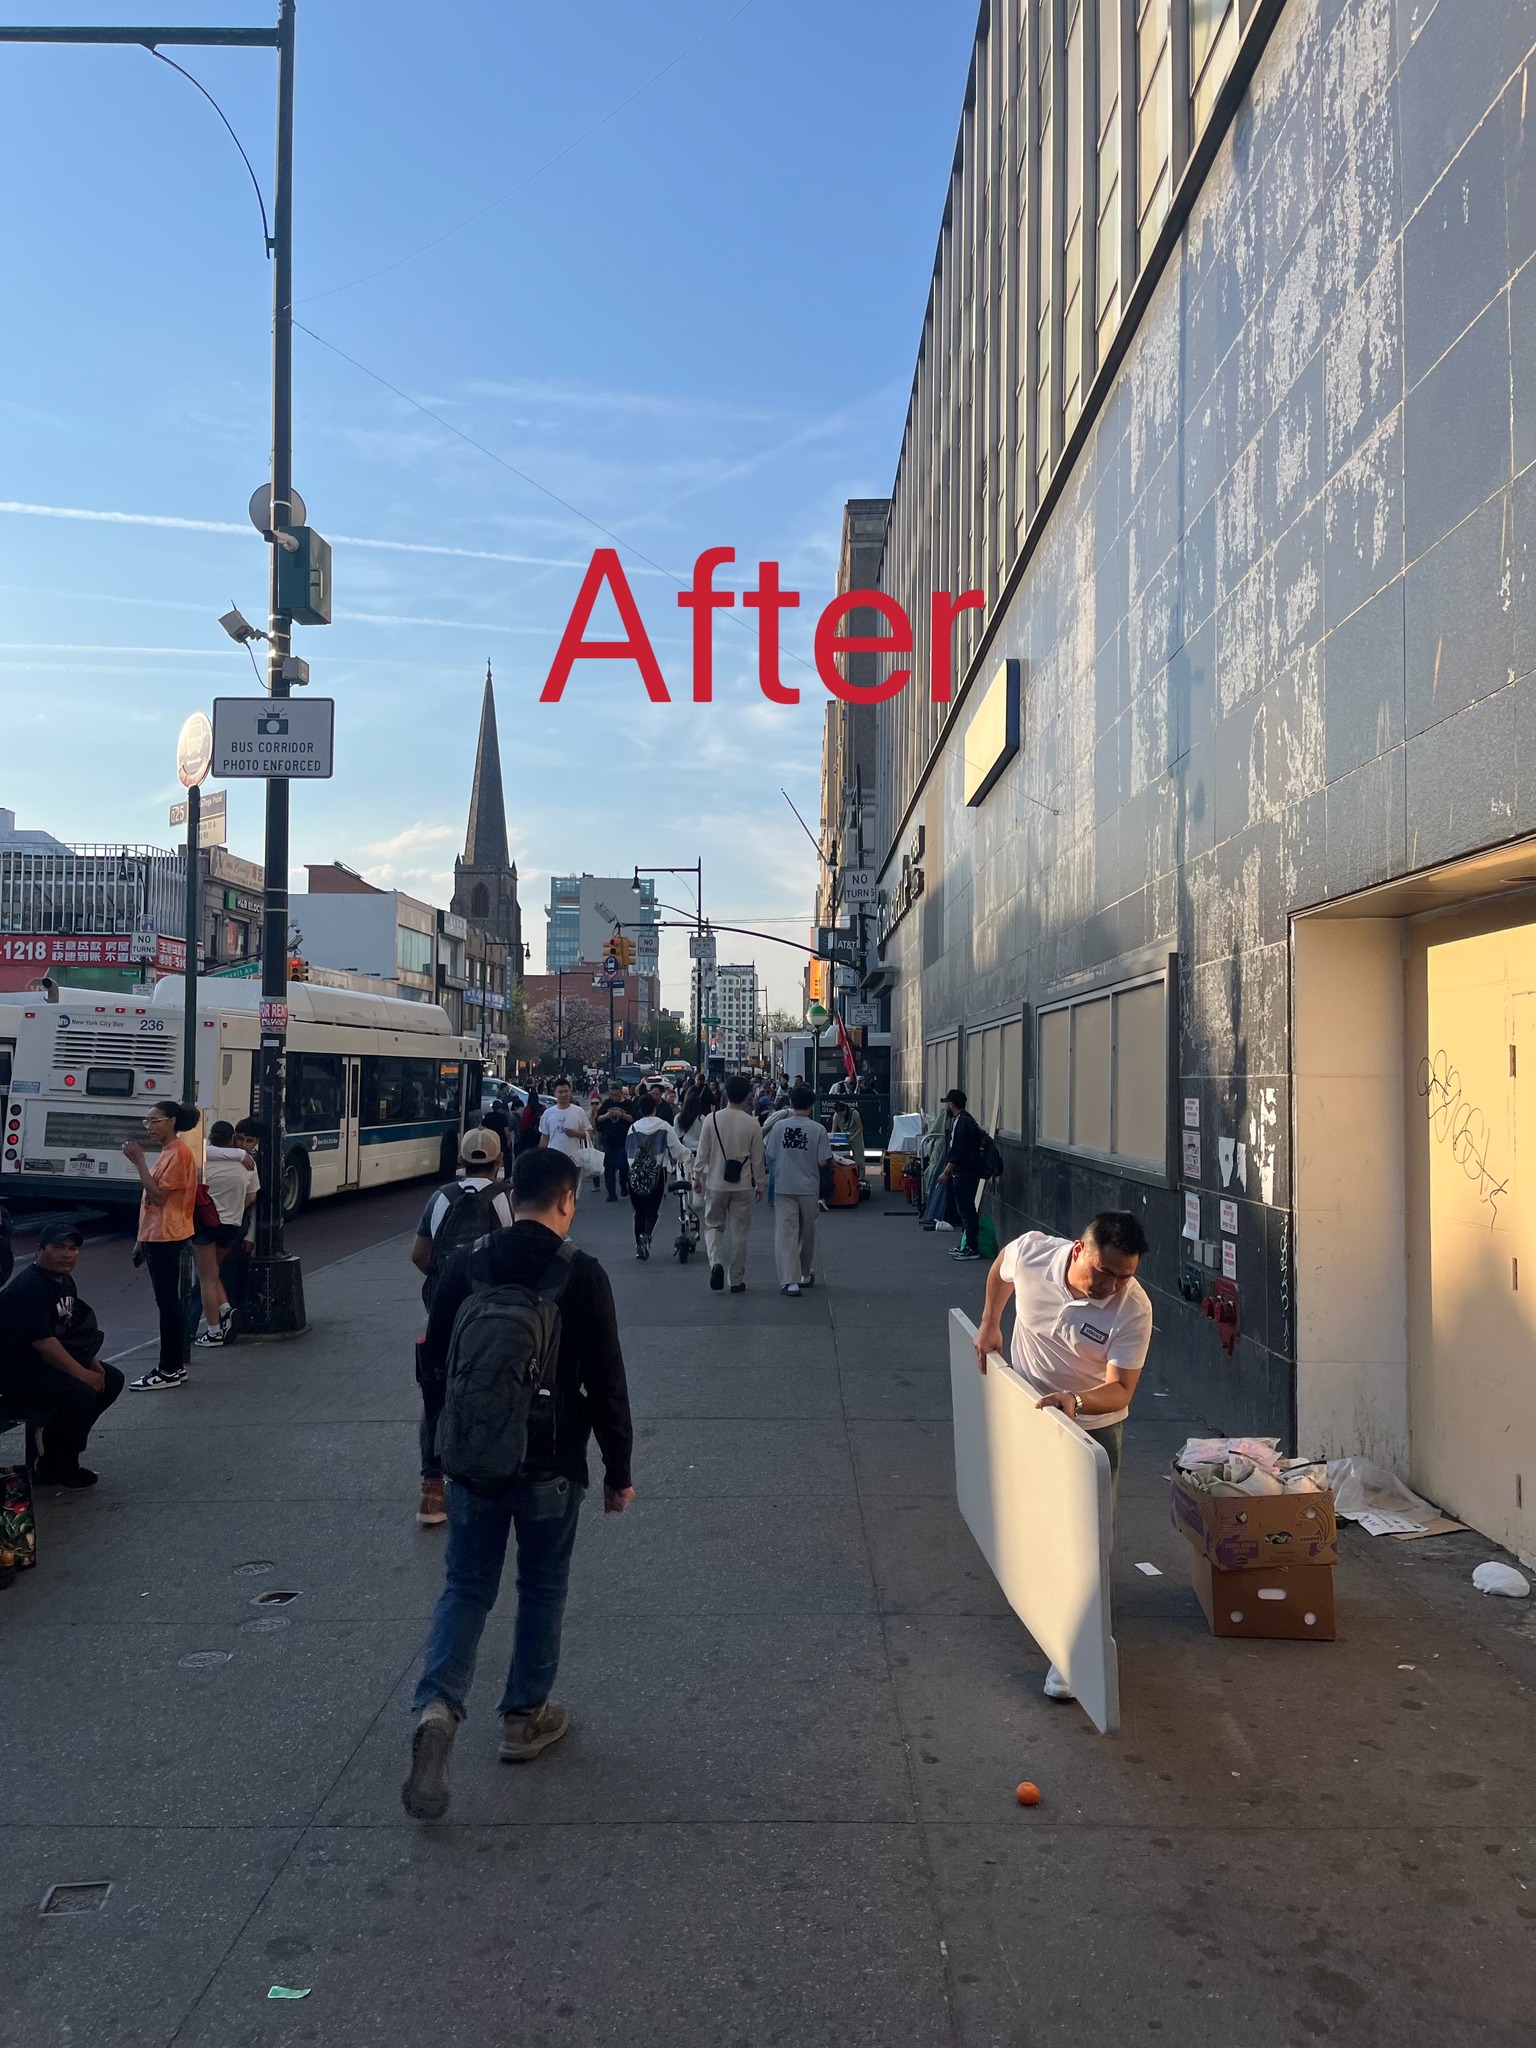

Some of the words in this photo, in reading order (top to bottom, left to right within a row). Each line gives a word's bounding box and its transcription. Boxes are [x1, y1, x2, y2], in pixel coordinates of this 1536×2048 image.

[231, 741, 253, 753] BUS
[258, 742, 314, 753] CORRIDOR
[223, 759, 259, 771] PHOTO
[263, 760, 321, 771] ENFORCED
[852, 873, 868, 884] NO
[846, 888, 875, 898] TURNS
[137, 935, 151, 943] NO
[3, 940, 47, 960] 1218
[837, 940, 857, 950] AT&T
[244, 967, 253, 975] Av
[271, 1003, 288, 1018] REN
[140, 1019, 164, 1031] 236
